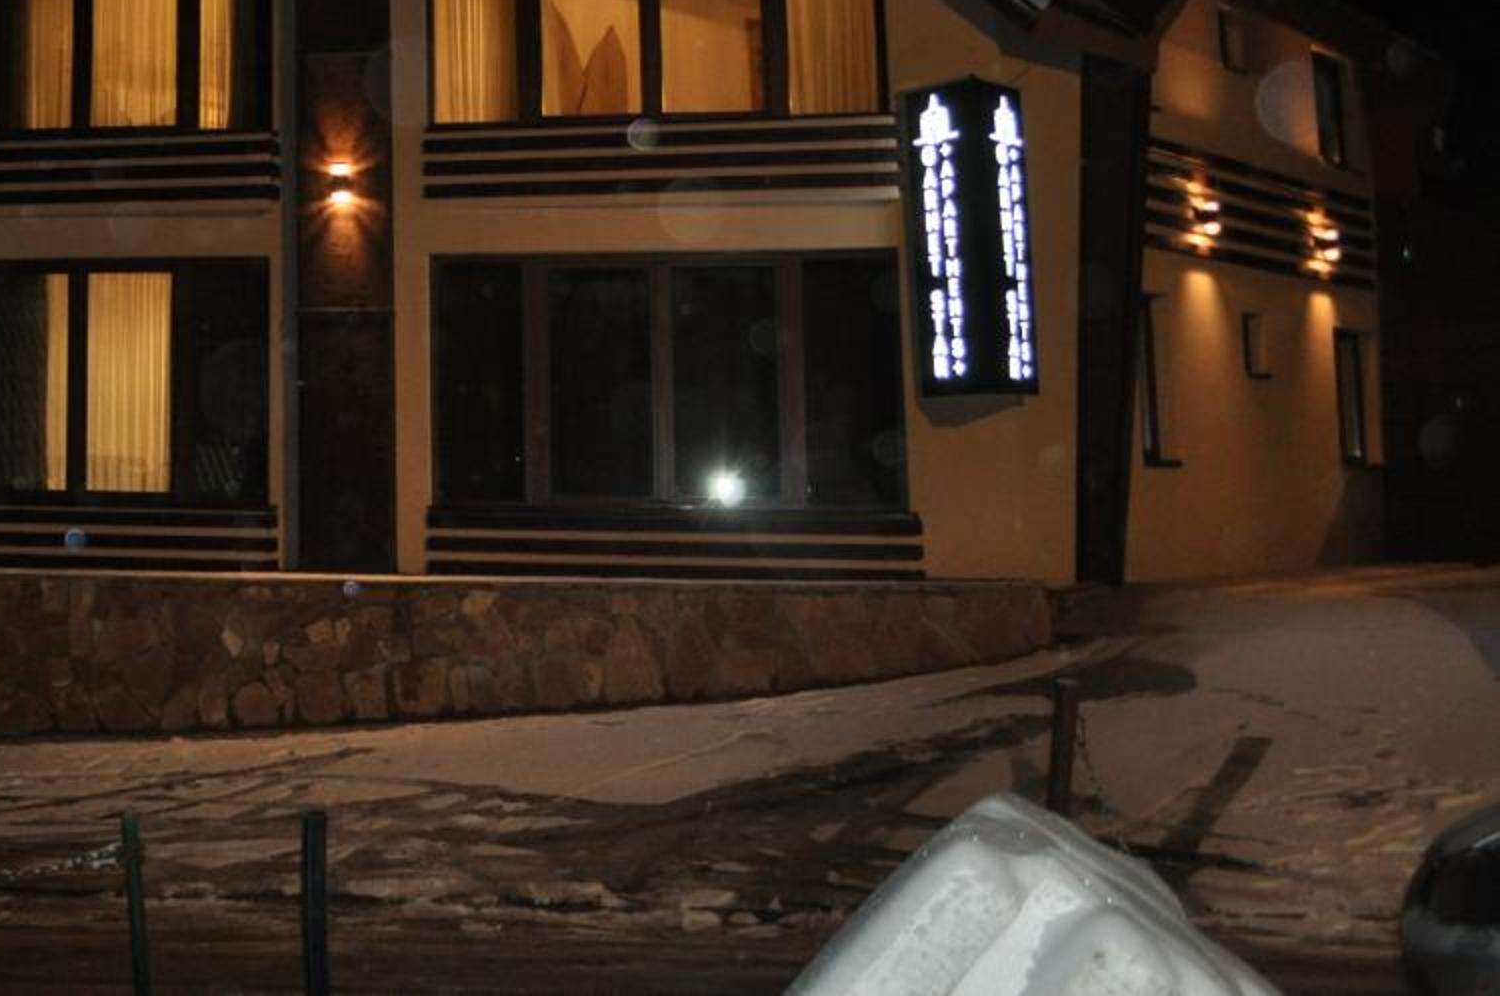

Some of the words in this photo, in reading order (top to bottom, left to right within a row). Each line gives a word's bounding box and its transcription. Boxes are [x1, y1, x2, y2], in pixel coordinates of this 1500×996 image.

[921, 143, 942, 277] GARNET
[941, 158, 965, 359] APARTMENTS
[930, 289, 950, 379] STAR
[1005, 289, 1022, 380] STAR
